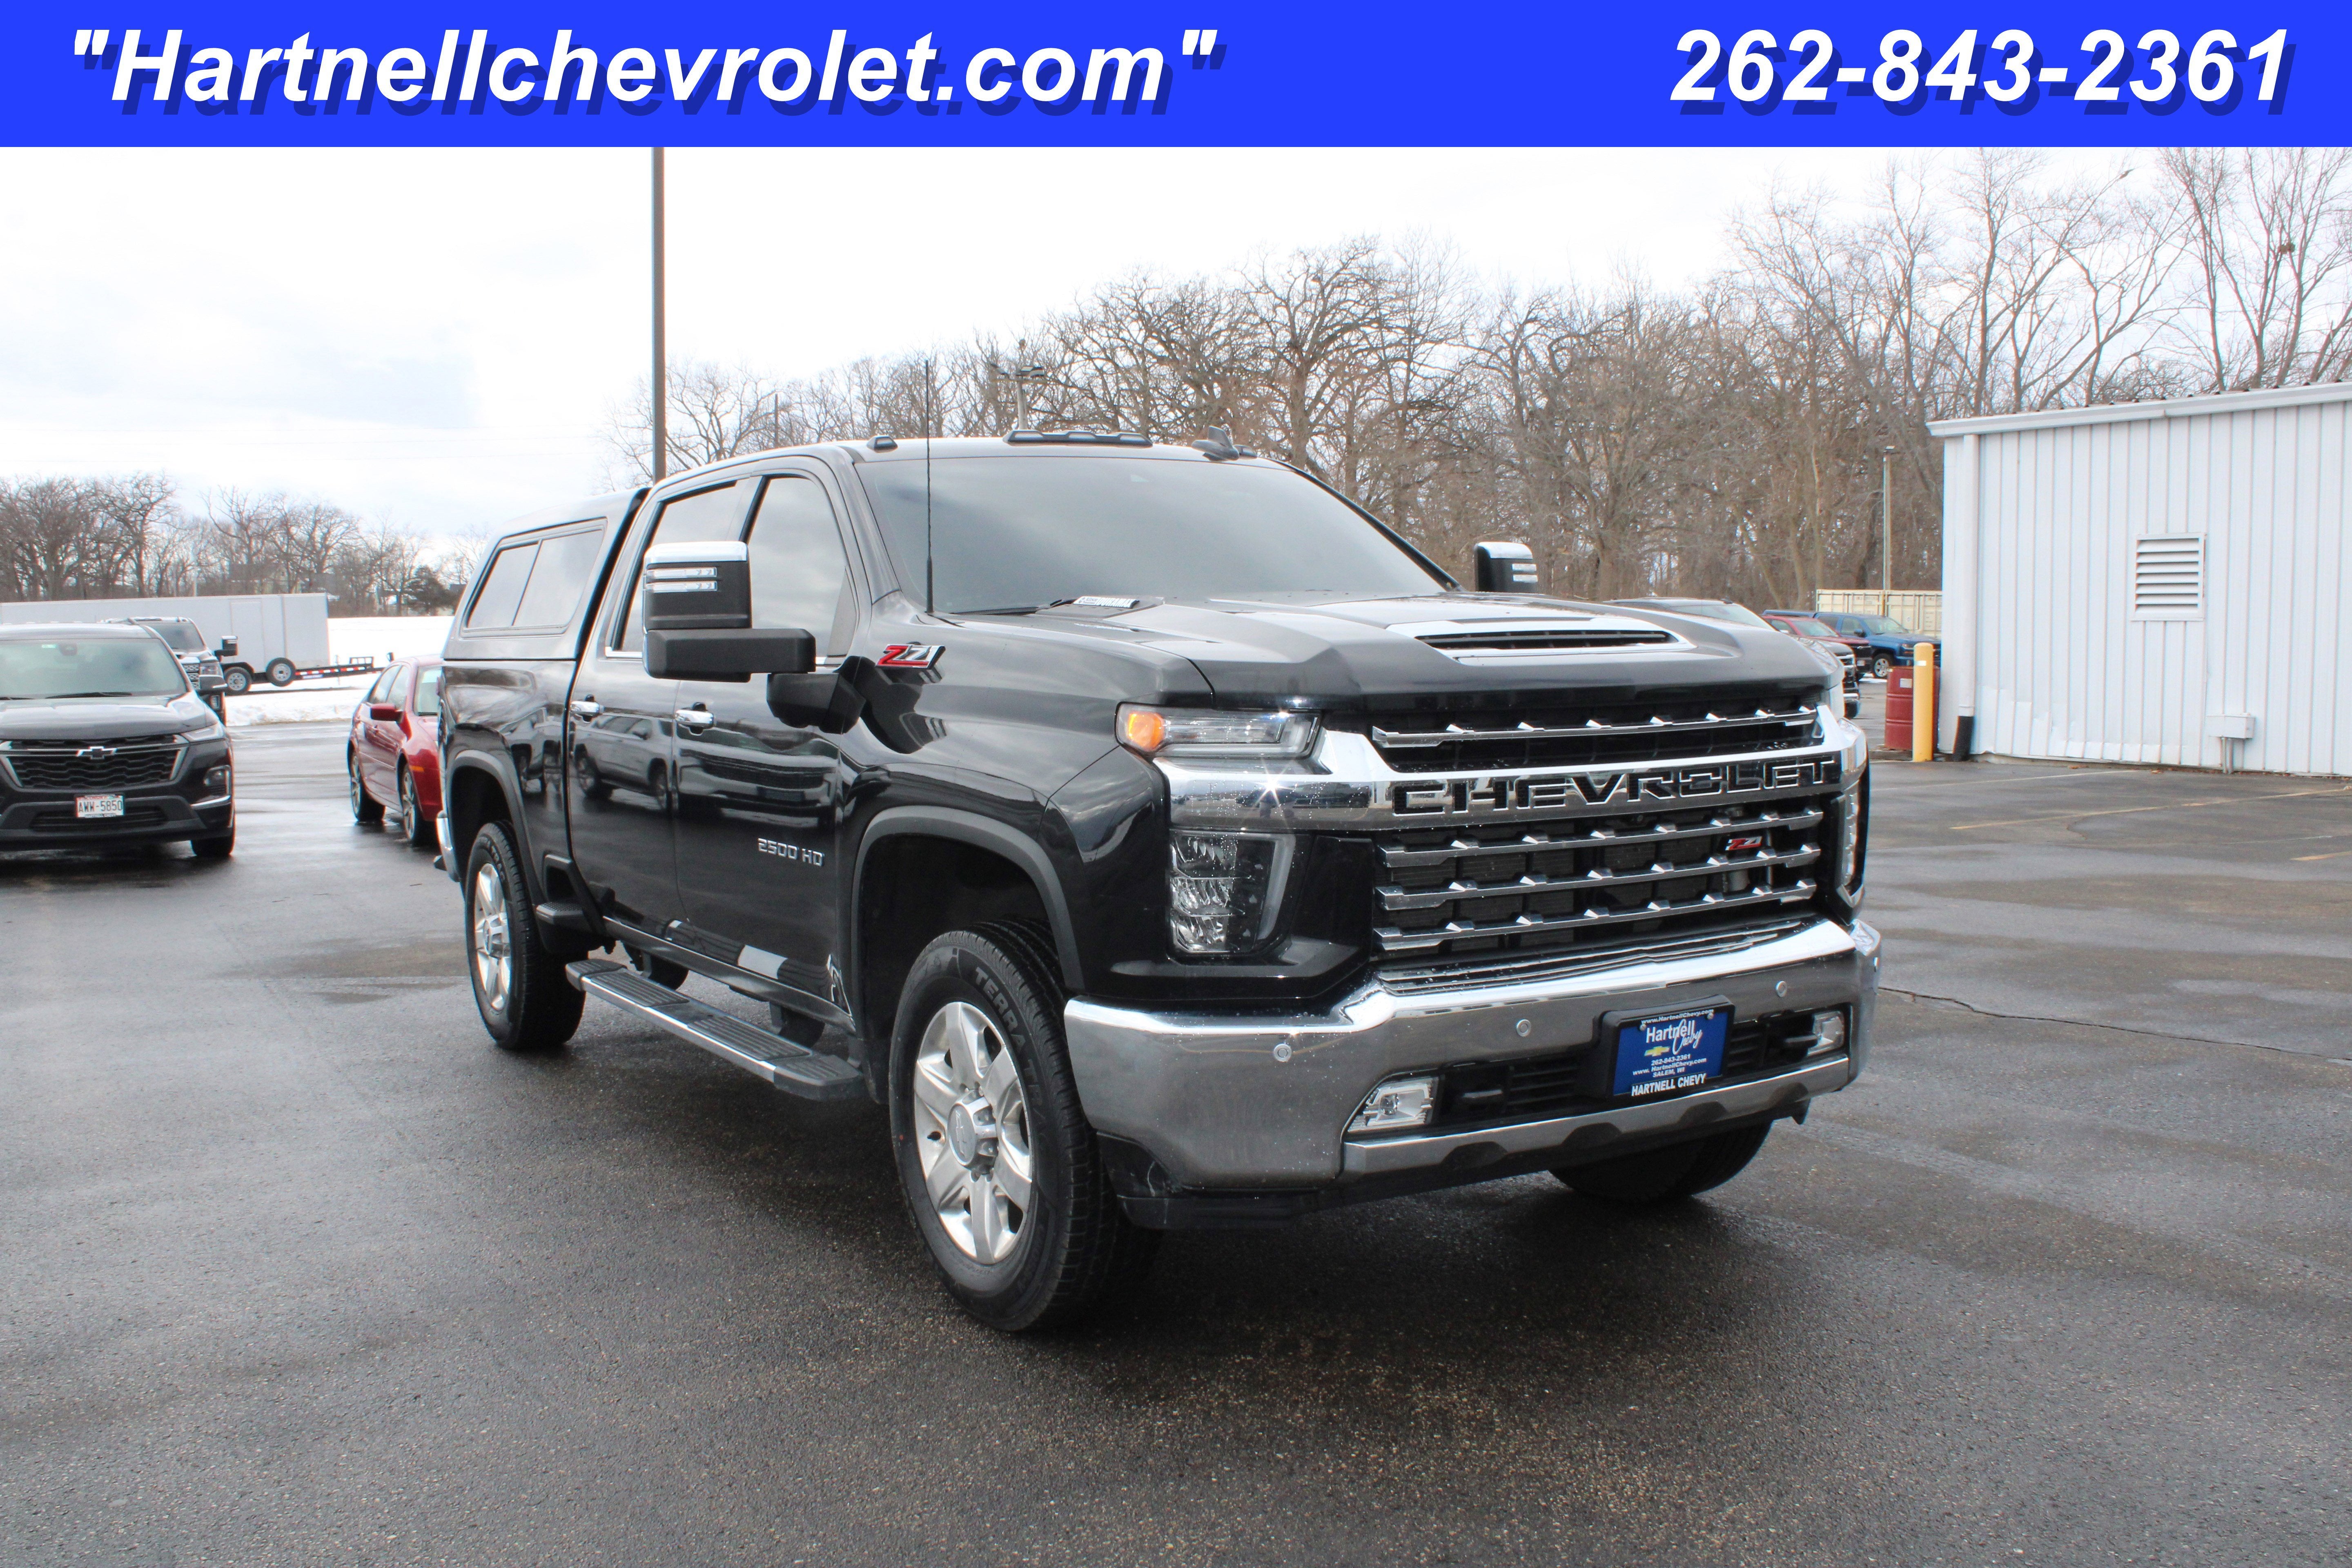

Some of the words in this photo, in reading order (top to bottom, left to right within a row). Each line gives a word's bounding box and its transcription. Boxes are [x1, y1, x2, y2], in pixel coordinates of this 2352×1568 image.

[1096, 597, 1136, 608] DURAMAX
[875, 644, 945, 669] Z71
[1392, 755, 1835, 817] CHEVROLET
[78, 800, 123, 813] AWW-5850
[1725, 836, 1763, 851] Z71
[757, 838, 799, 860] 2500
[802, 848, 824, 867] HD
[975, 966, 1026, 1050] TERRA
[1641, 1009, 1714, 1024] www.HartnellChevy.com
[1646, 1019, 1695, 1043] Hartnell
[1651, 1053, 1691, 1066] 262-843-2361
[1651, 1058, 1707, 1072] HartnellChevy.com
[1652, 1069, 1676, 1078] SALEM,
[1631, 1078, 1676, 1097] HARTNELL
[1677, 1072, 1707, 1088] CHEVY
